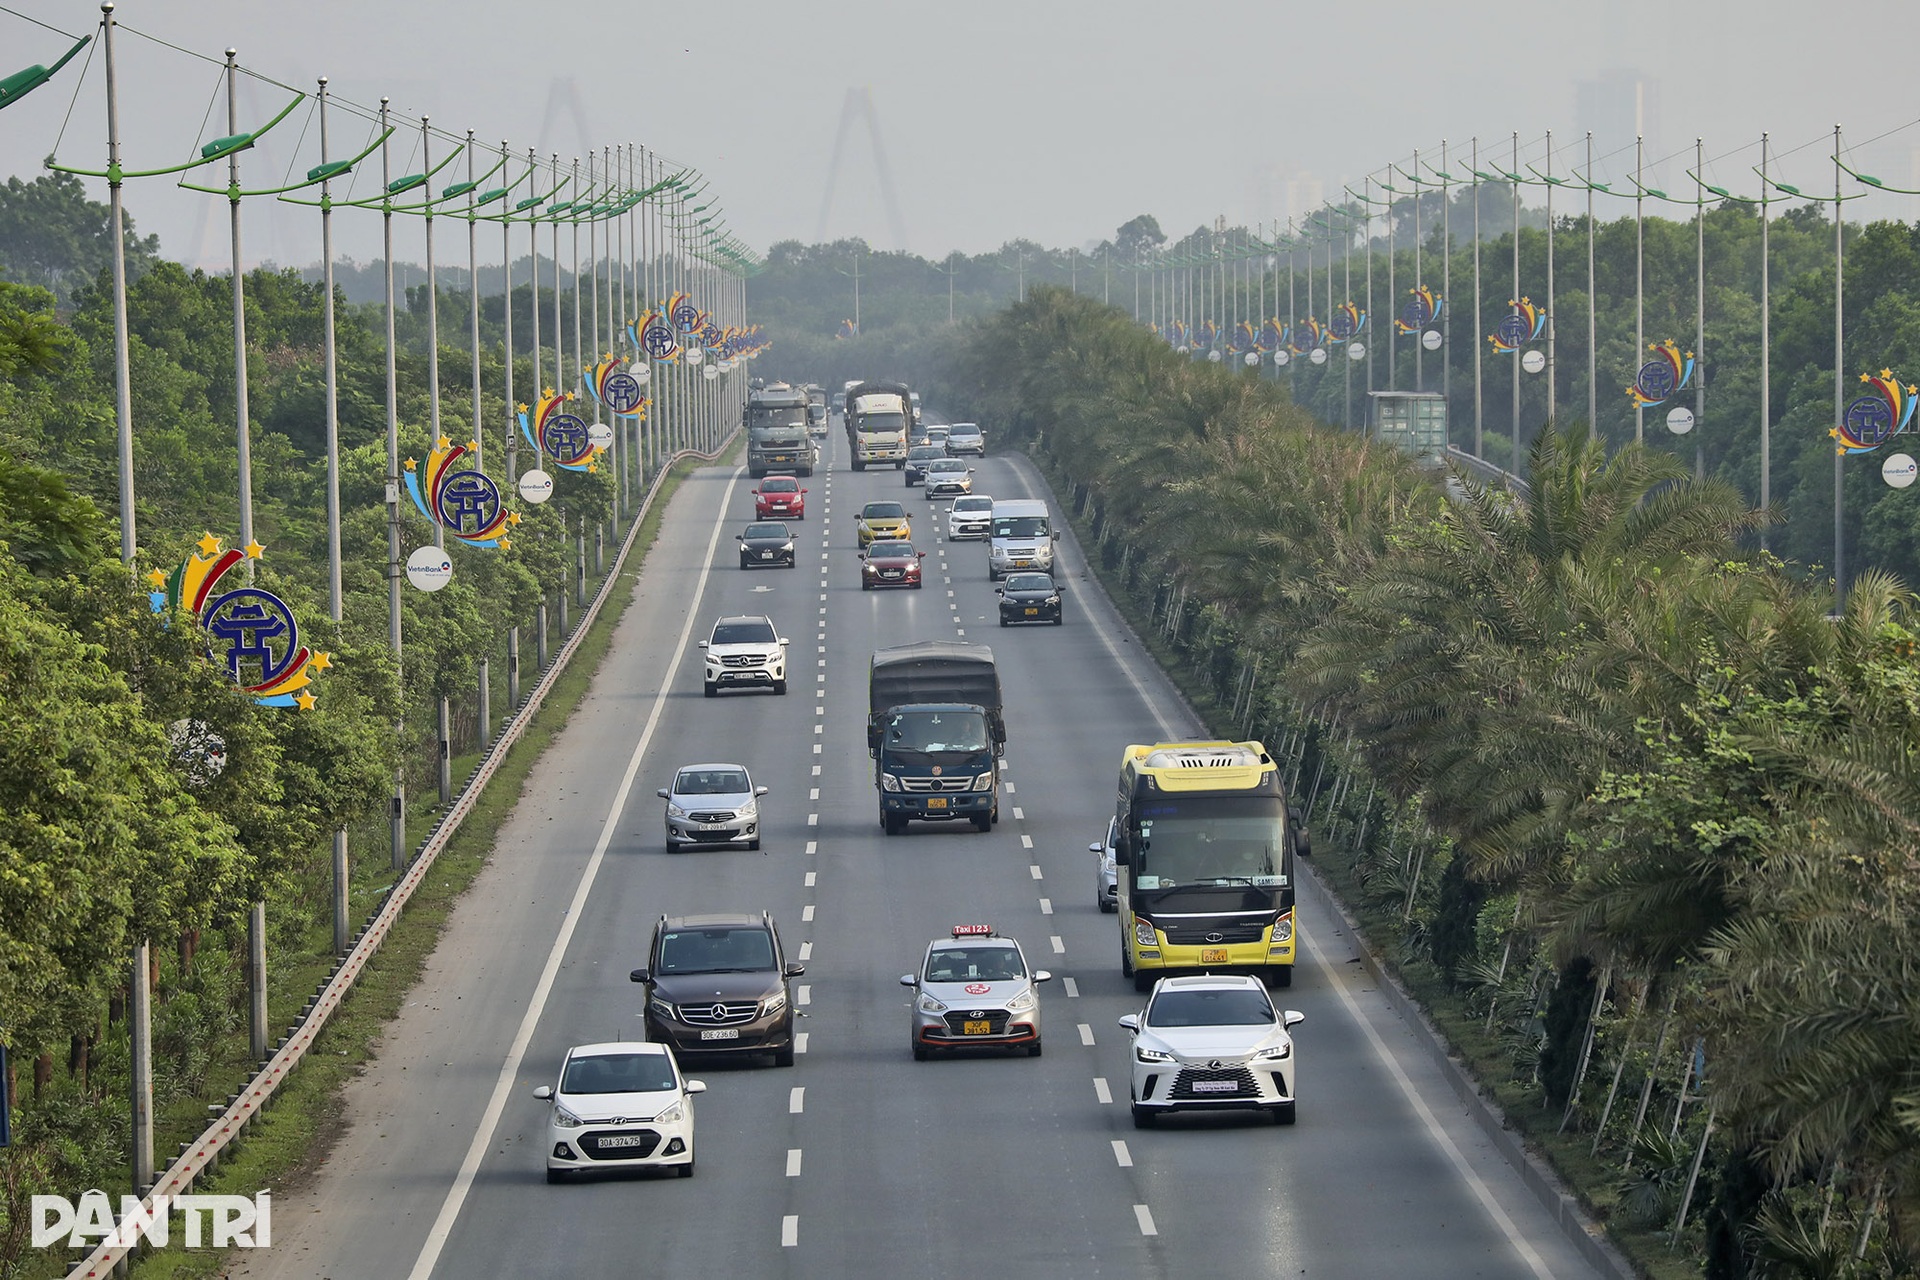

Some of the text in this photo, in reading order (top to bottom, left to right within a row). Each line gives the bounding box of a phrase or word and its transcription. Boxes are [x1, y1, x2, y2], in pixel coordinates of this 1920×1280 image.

[407, 565, 442, 573] VietinBank
[954, 924, 989, 933] Taxi 123
